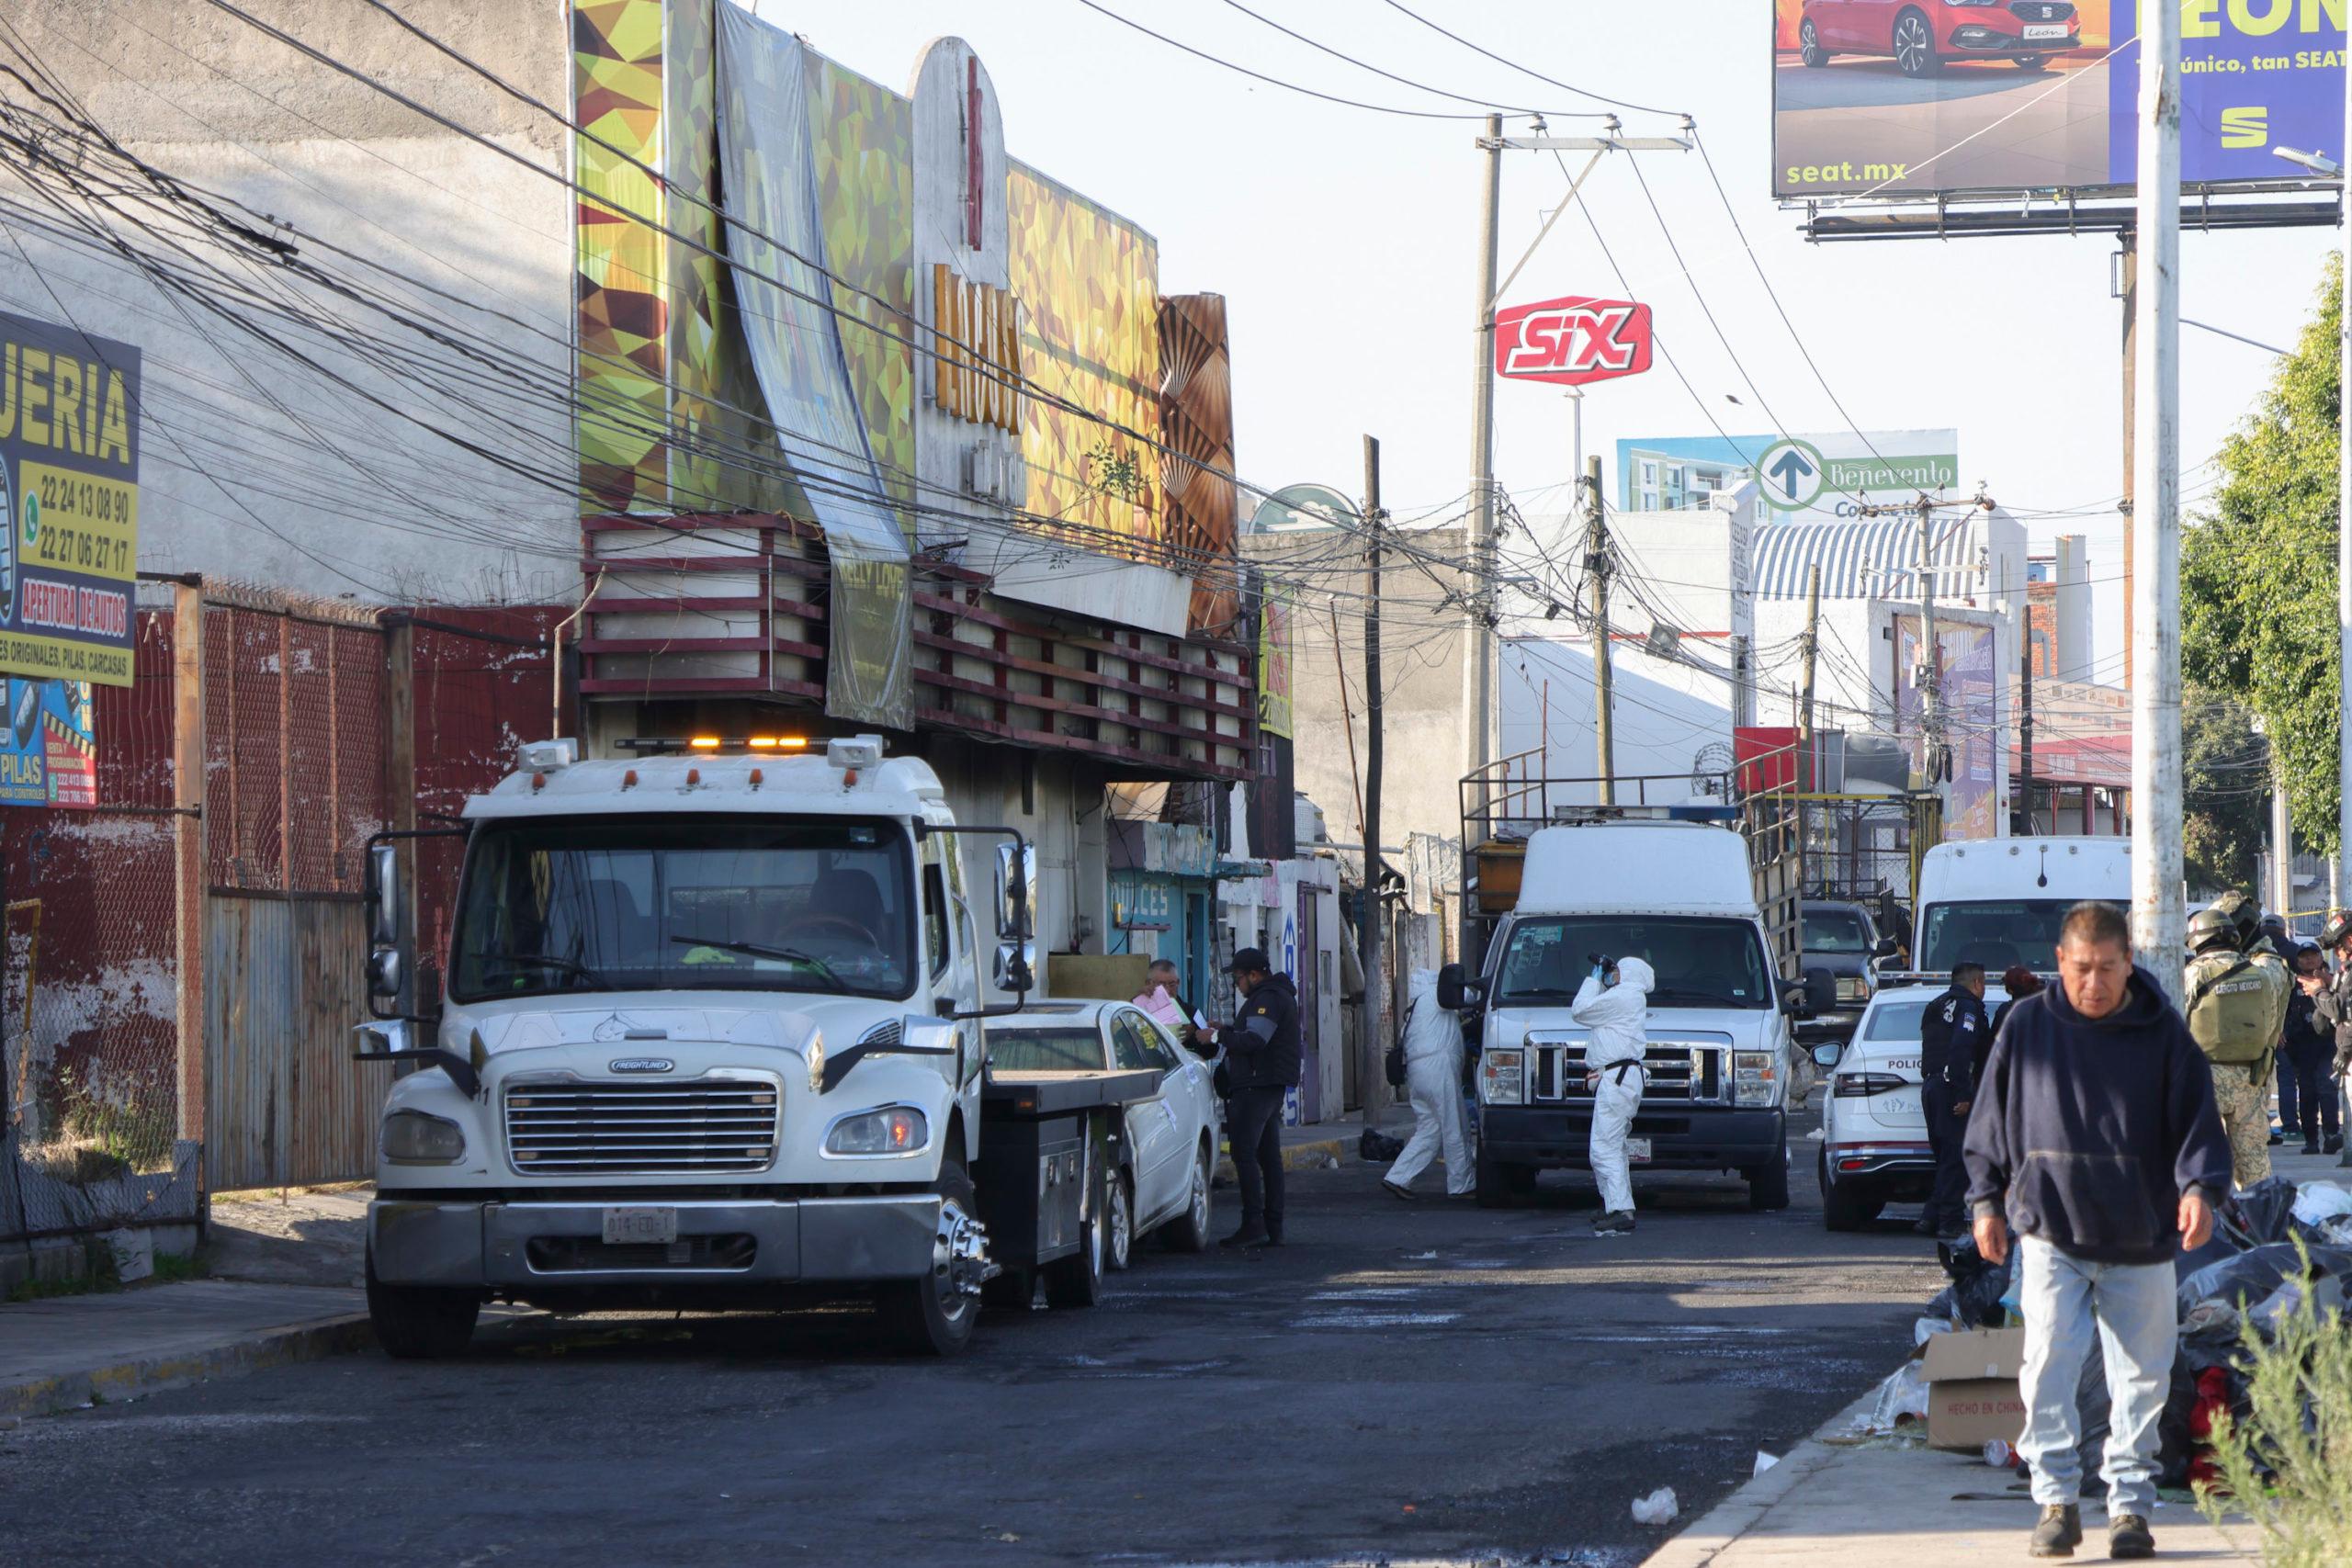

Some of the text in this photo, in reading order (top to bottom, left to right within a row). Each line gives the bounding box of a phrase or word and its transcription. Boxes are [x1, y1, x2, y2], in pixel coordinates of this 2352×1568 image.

[2180, 50, 2346, 73] único, tan SEAT
[1787, 161, 1906, 184] seat.mx
[1831, 460, 1951, 486] Benevento
[41, 474, 128, 525] 22 24 13 08 90
[40, 525, 128, 572] 22 27 06 27 17
[22, 579, 127, 637] APERTURA DE AUTOS
[11, 640, 61, 671] ORIGINALES,
[63, 647, 86, 673] PILAS,
[88, 652, 127, 677] CARCASAS
[1, 753, 42, 785] PILAS
[616, 1060, 667, 1070] FREIGHTLINER
[1948, 1403, 1978, 1415] HECHO
[1983, 1402, 1994, 1414] EN
